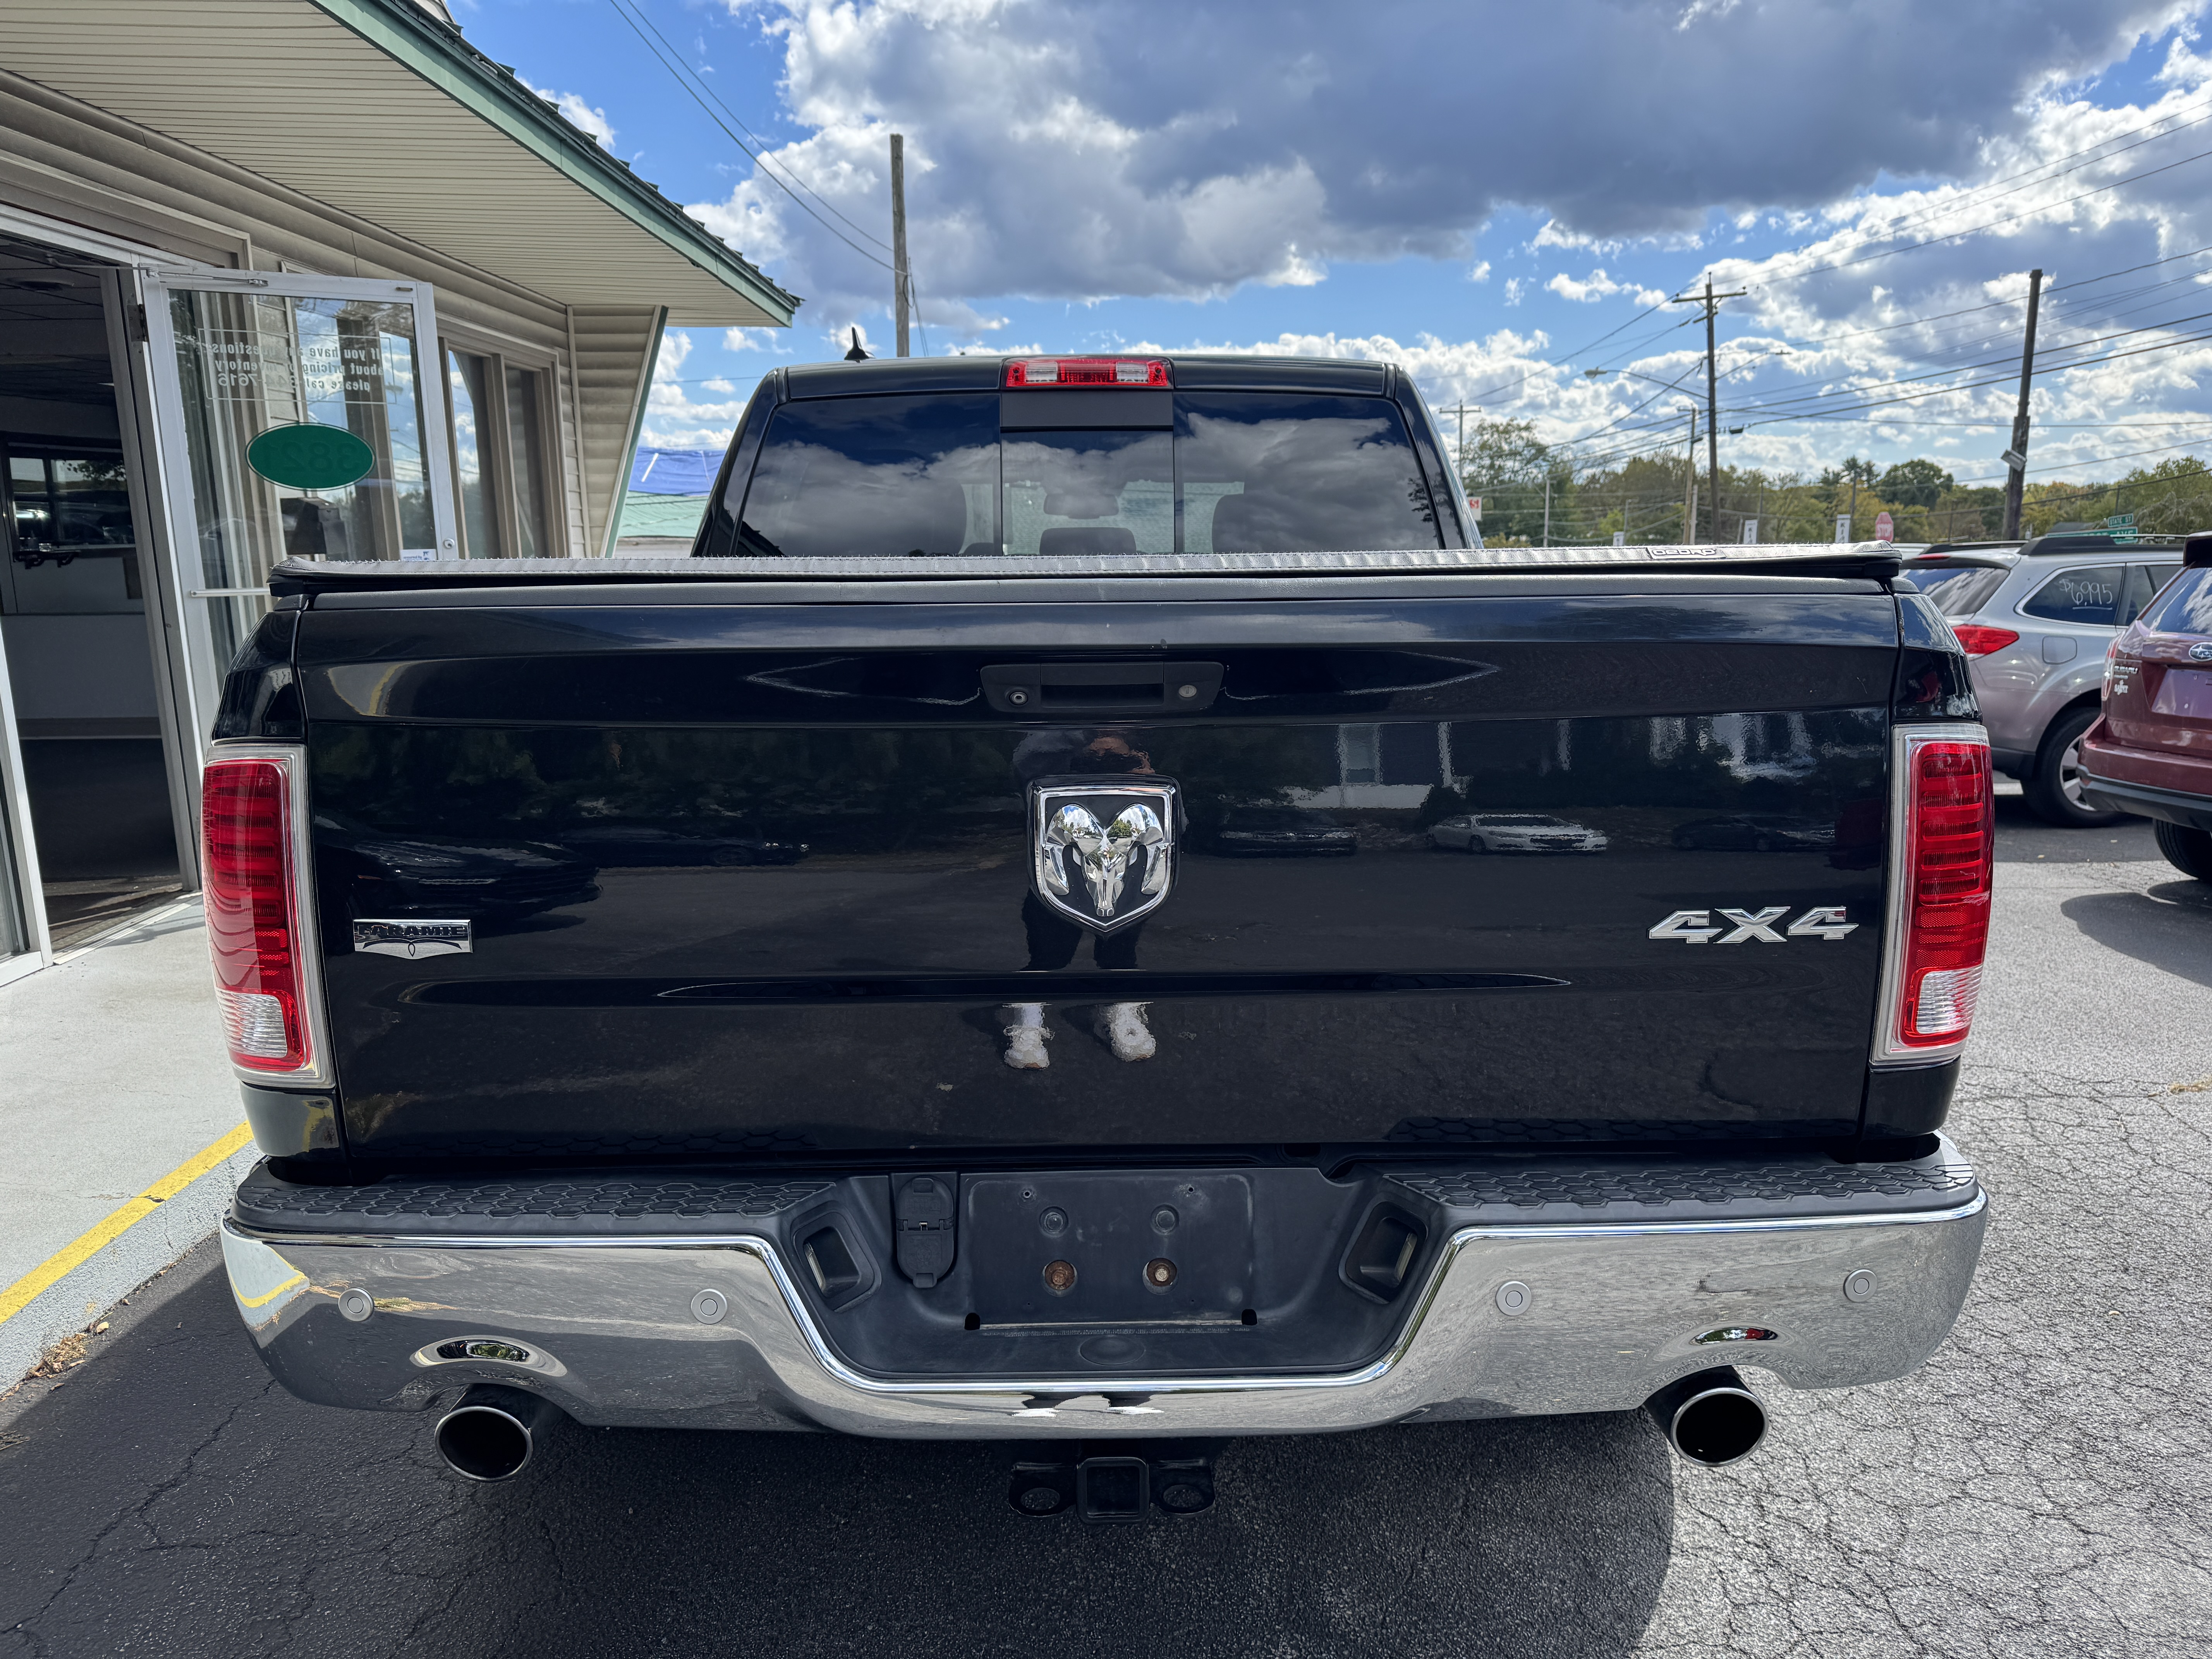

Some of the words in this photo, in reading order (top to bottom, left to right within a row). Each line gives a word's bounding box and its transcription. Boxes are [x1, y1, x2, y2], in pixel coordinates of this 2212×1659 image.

[1877, 524, 1891, 537] STOP
[2109, 517, 2122, 526] STATE
[2059, 579, 2112, 606] $6,995
[1649, 906, 1859, 944] 4X4
